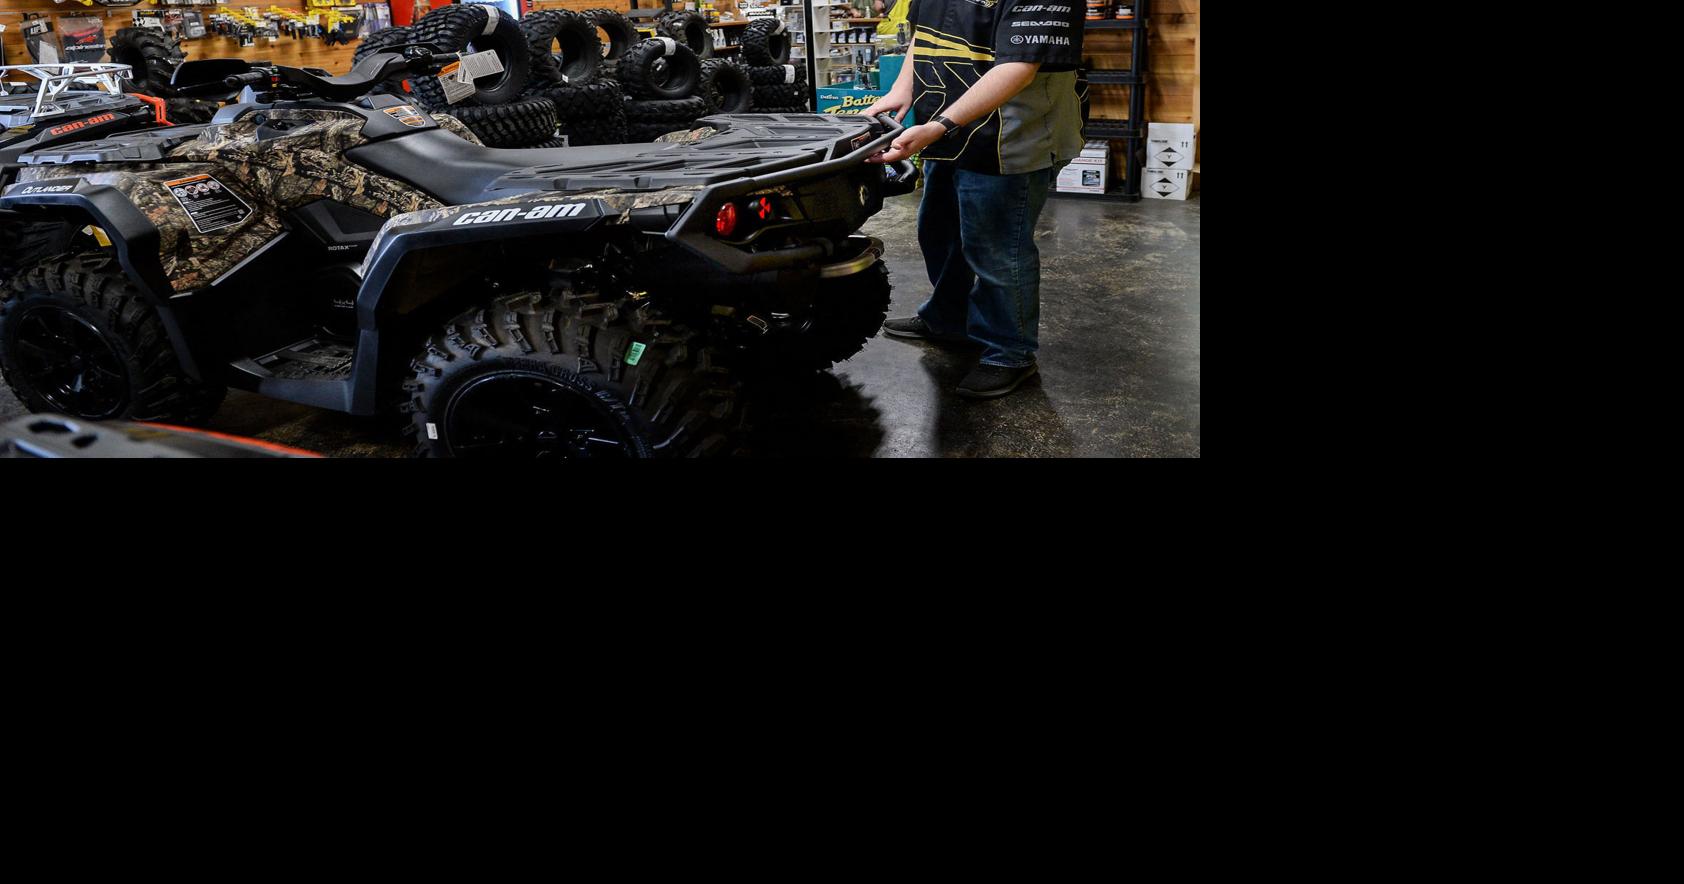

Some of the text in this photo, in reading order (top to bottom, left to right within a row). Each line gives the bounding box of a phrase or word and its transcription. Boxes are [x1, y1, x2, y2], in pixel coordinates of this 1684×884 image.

[1024, 35, 1070, 46] YAMAHA
[20, 185, 74, 195] OUTLANDER
[453, 203, 587, 226] can-am
